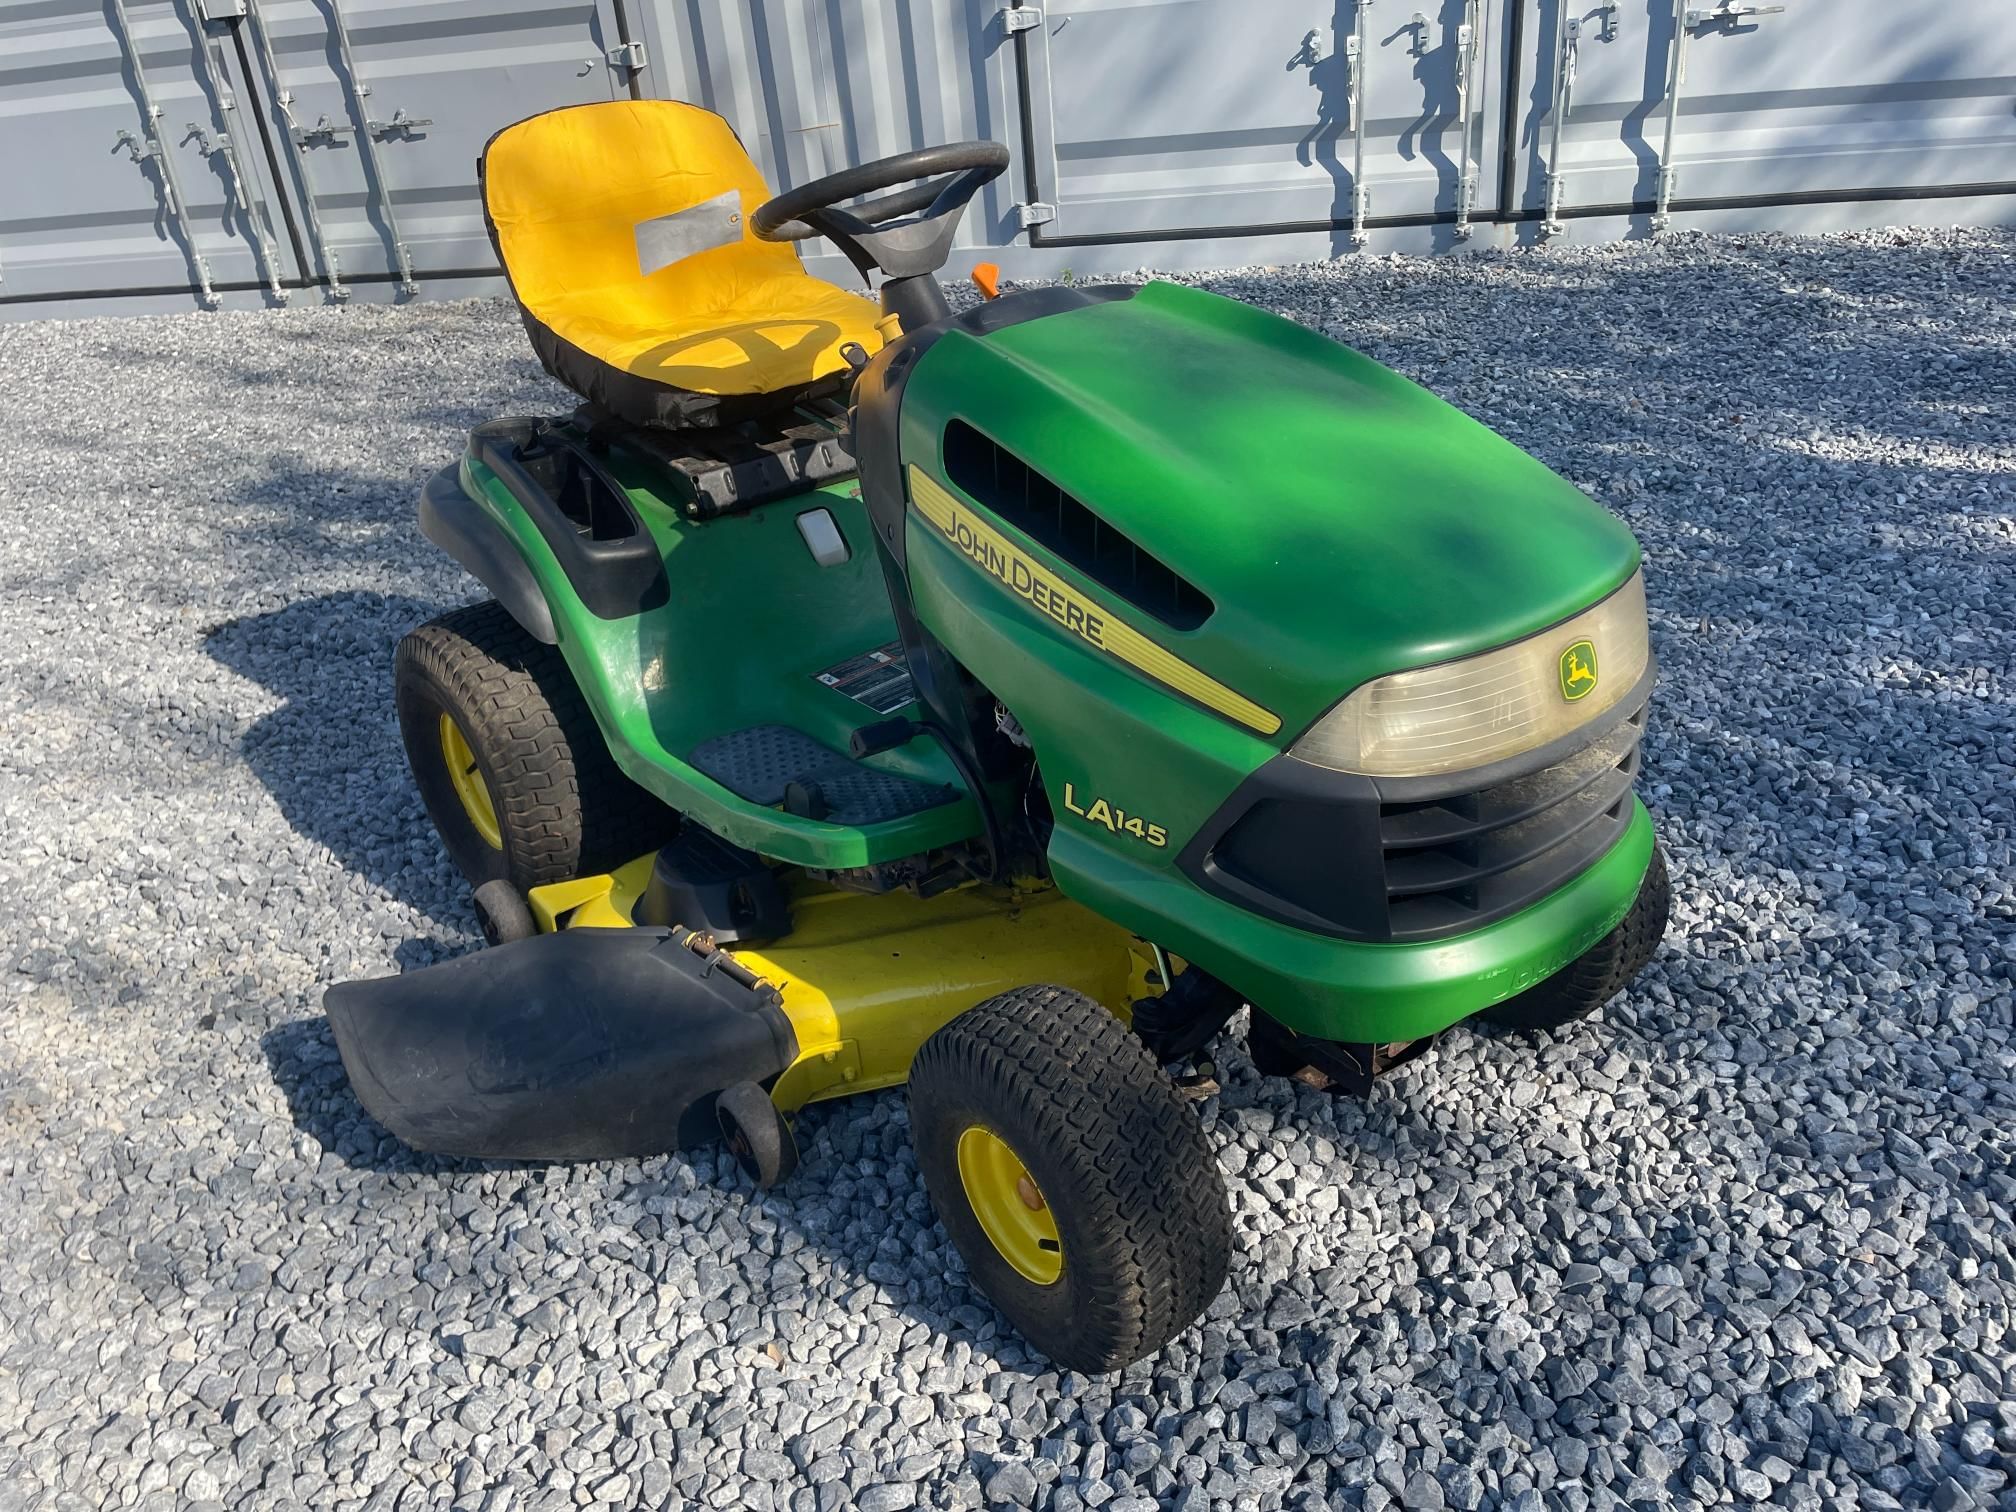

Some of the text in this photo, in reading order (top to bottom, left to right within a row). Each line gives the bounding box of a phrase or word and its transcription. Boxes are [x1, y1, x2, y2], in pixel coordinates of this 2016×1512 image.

[945, 511, 1104, 646] JOHN DEERE
[1064, 782, 1167, 847] LA145
